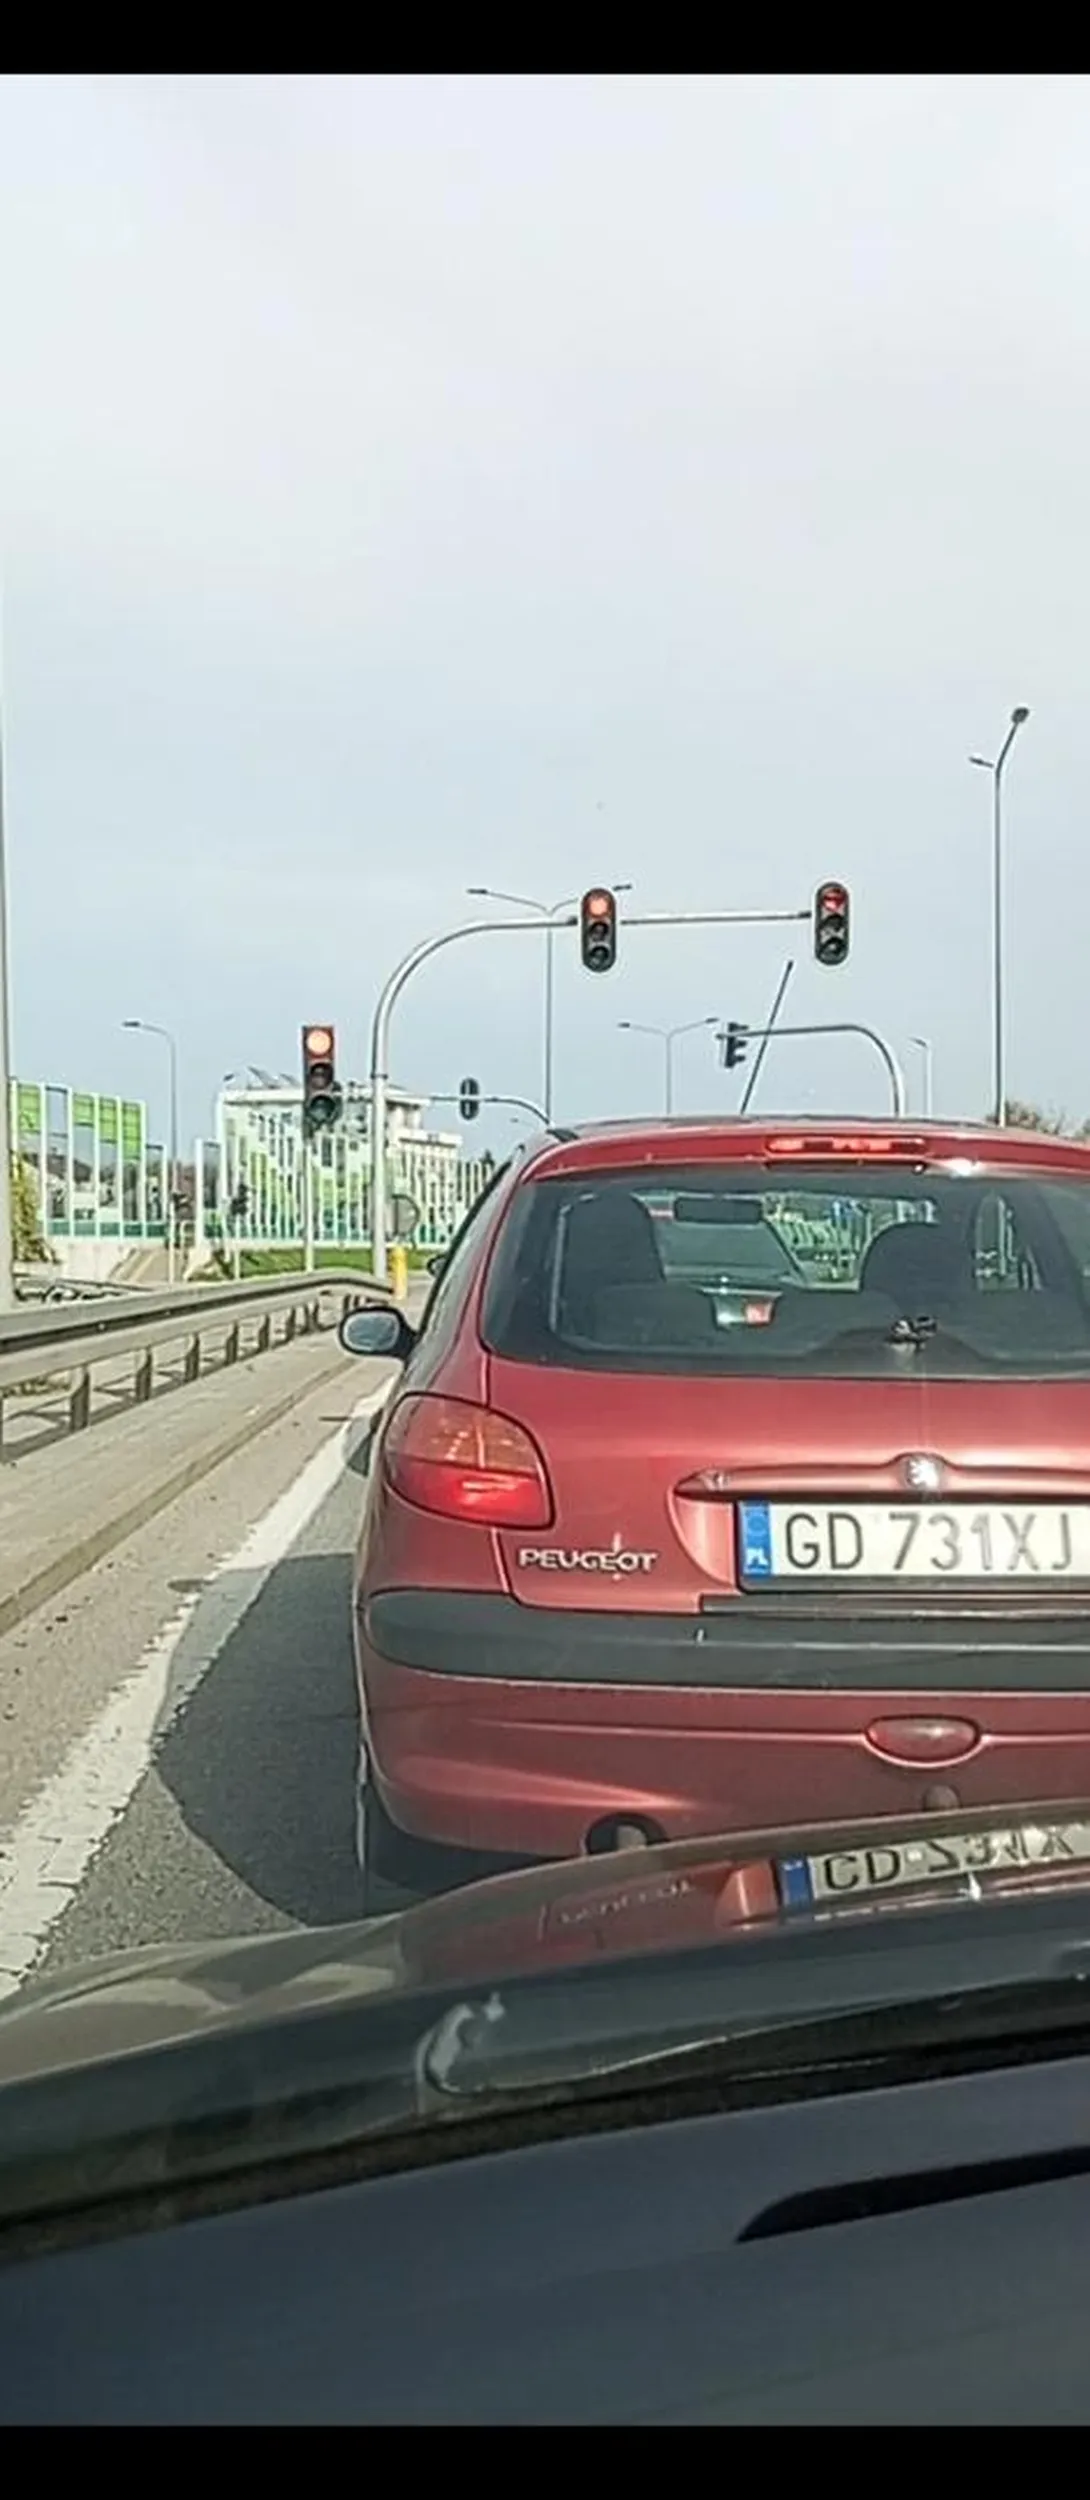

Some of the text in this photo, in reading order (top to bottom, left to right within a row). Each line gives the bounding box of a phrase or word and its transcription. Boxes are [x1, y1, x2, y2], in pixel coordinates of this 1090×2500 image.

[518, 1547, 658, 1572] PEUGEOT
[786, 1510, 1073, 1572] GD 731XJ
